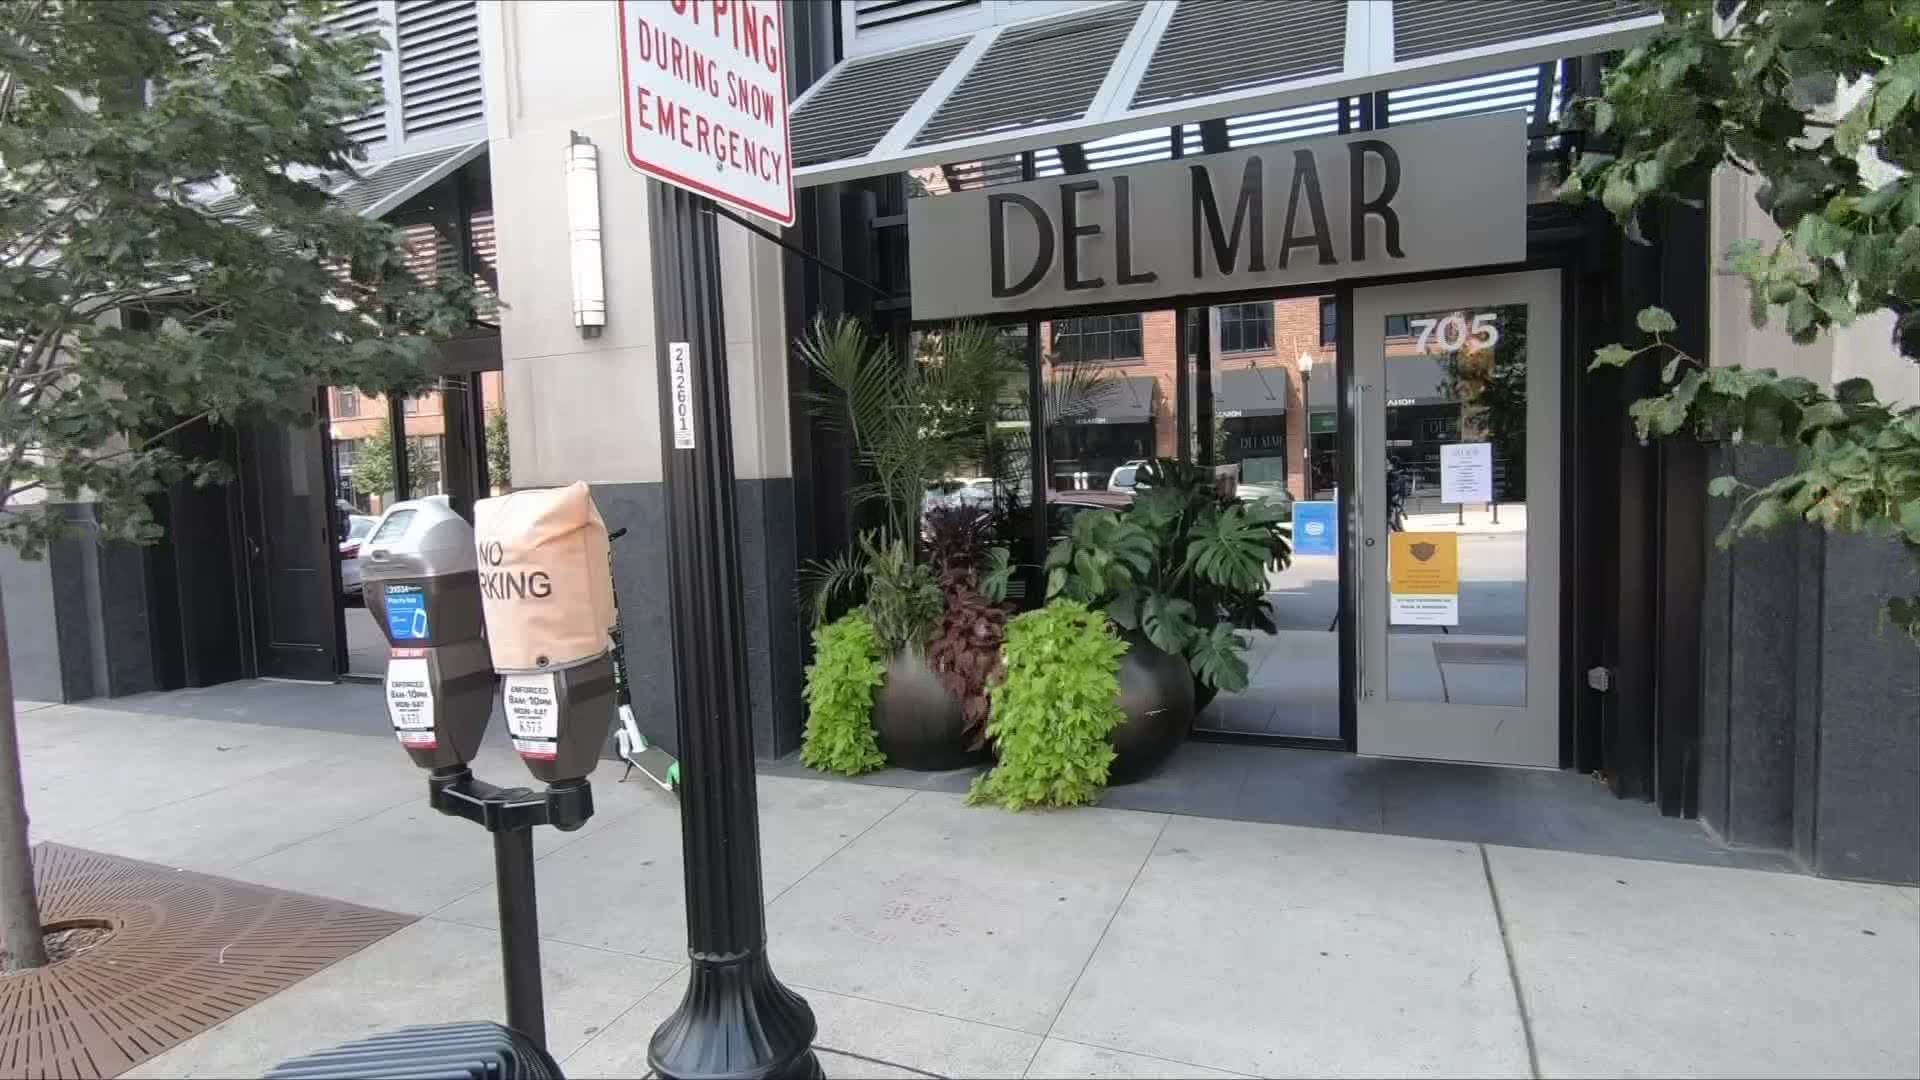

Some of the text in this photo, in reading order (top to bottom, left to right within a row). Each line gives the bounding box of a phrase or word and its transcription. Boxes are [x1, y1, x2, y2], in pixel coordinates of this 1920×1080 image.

[638, 18, 774, 128] DURING SNOW
[637, 85, 781, 185] EMERGENCY
[988, 140, 1405, 298] DEL MAR
[1410, 313, 1499, 353] 705
[675, 347, 688, 430] 242601
[480, 540, 503, 567] NO
